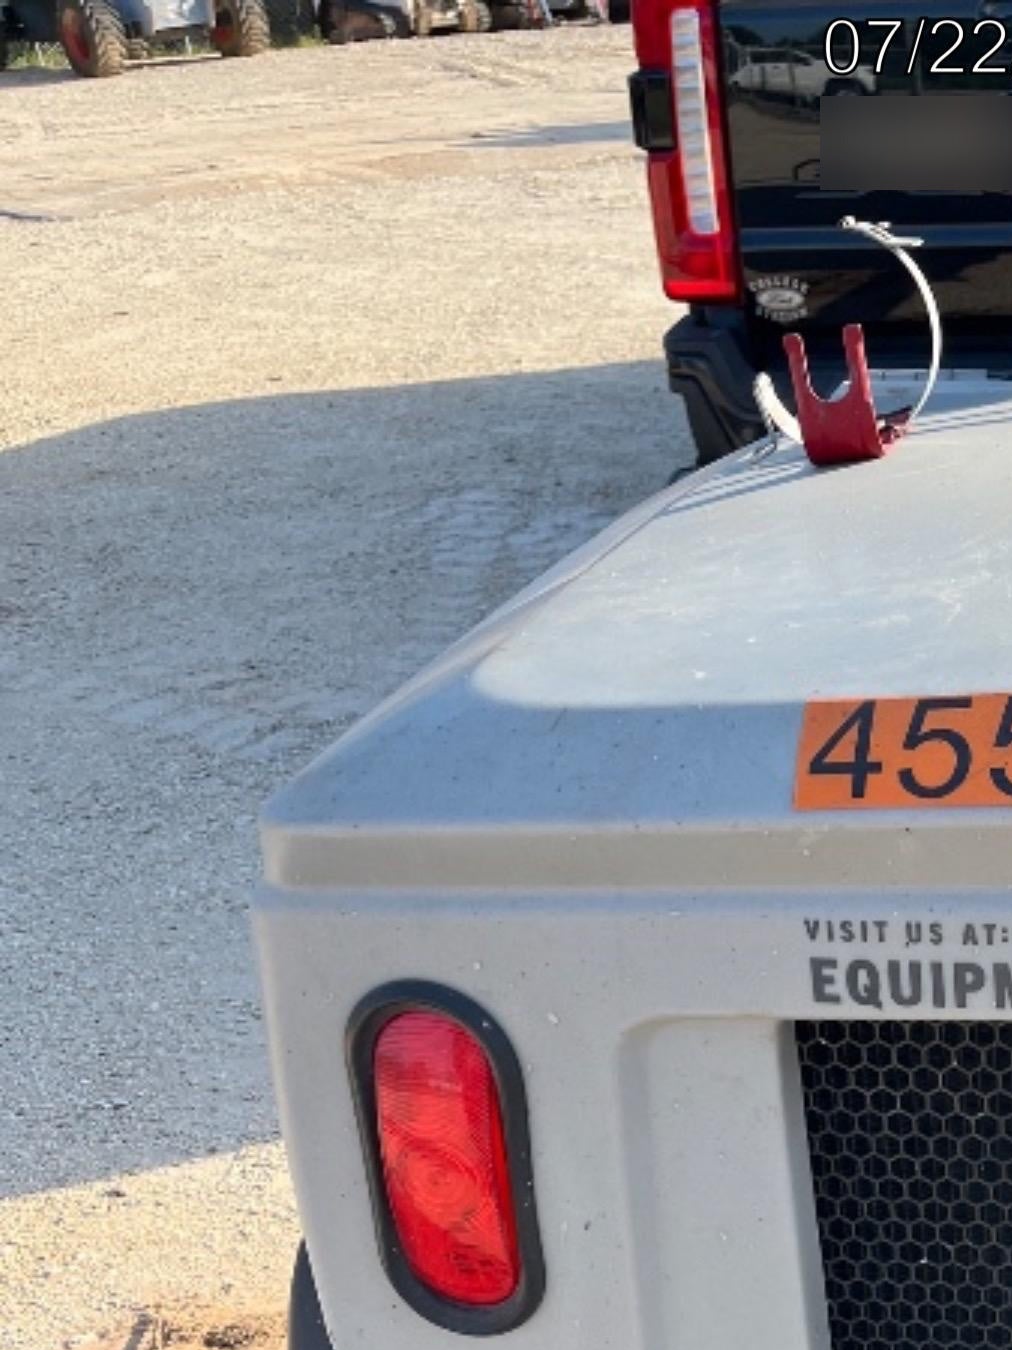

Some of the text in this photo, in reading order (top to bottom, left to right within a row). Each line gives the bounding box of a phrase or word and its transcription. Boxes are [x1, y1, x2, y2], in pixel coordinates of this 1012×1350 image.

[804, 920, 1009, 947] VISIT US AT:
